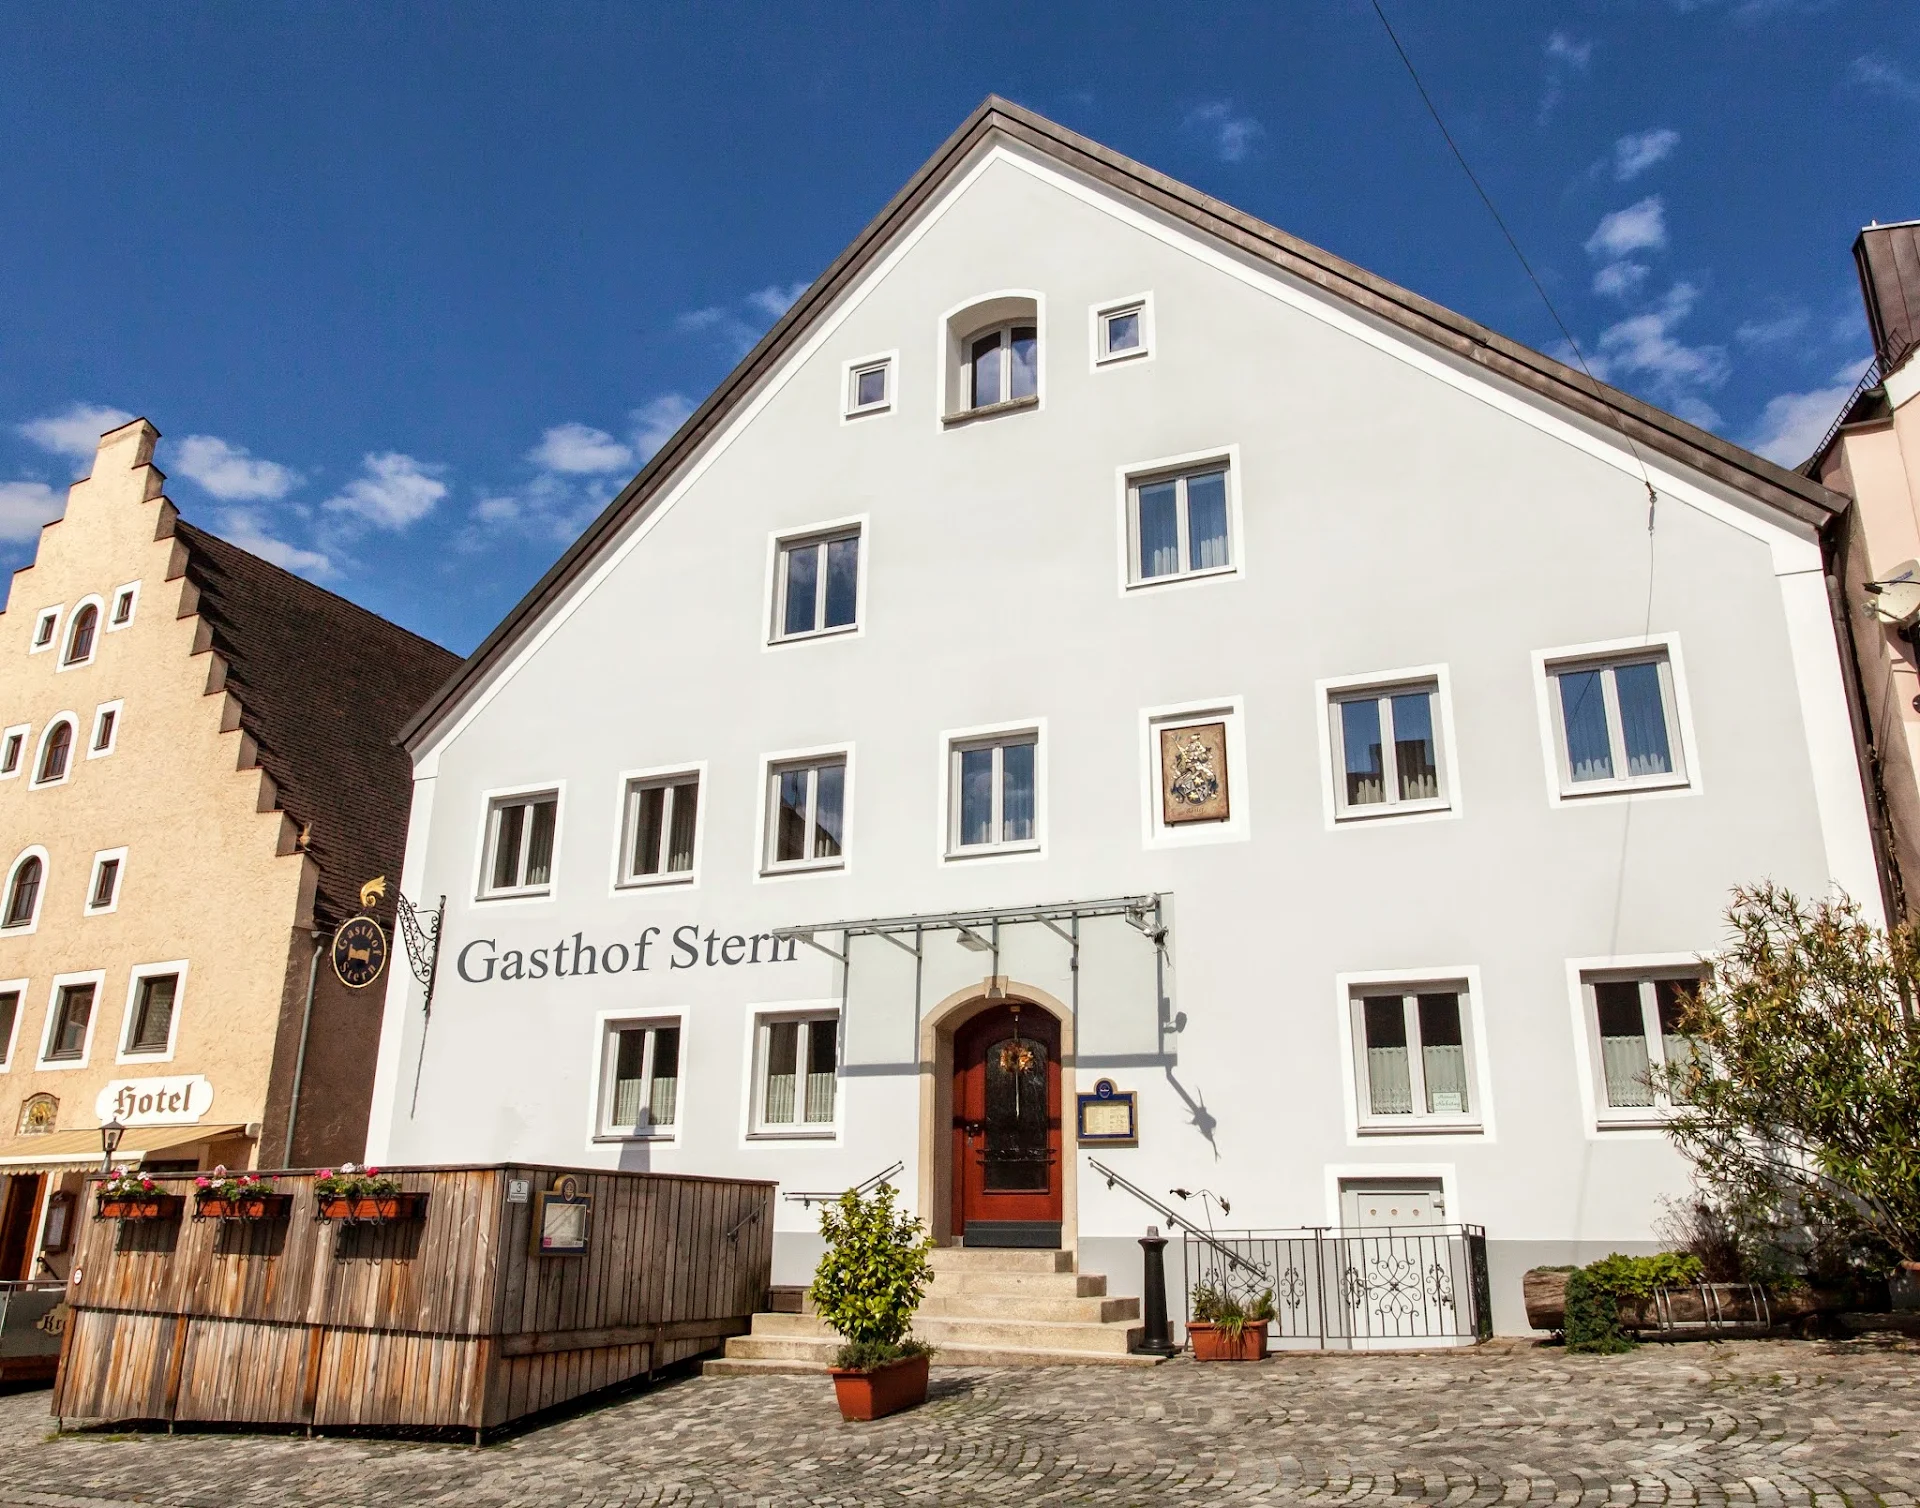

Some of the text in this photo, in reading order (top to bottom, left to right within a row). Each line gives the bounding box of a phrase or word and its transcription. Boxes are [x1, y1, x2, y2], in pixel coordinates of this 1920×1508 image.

[338, 925, 382, 956] Gasthof
[457, 924, 798, 983] Gasthof Stern
[340, 961, 376, 982] Stern
[113, 1081, 195, 1121] Hotel
[516, 1182, 522, 1193] 3
[43, 1315, 66, 1332] Kr
